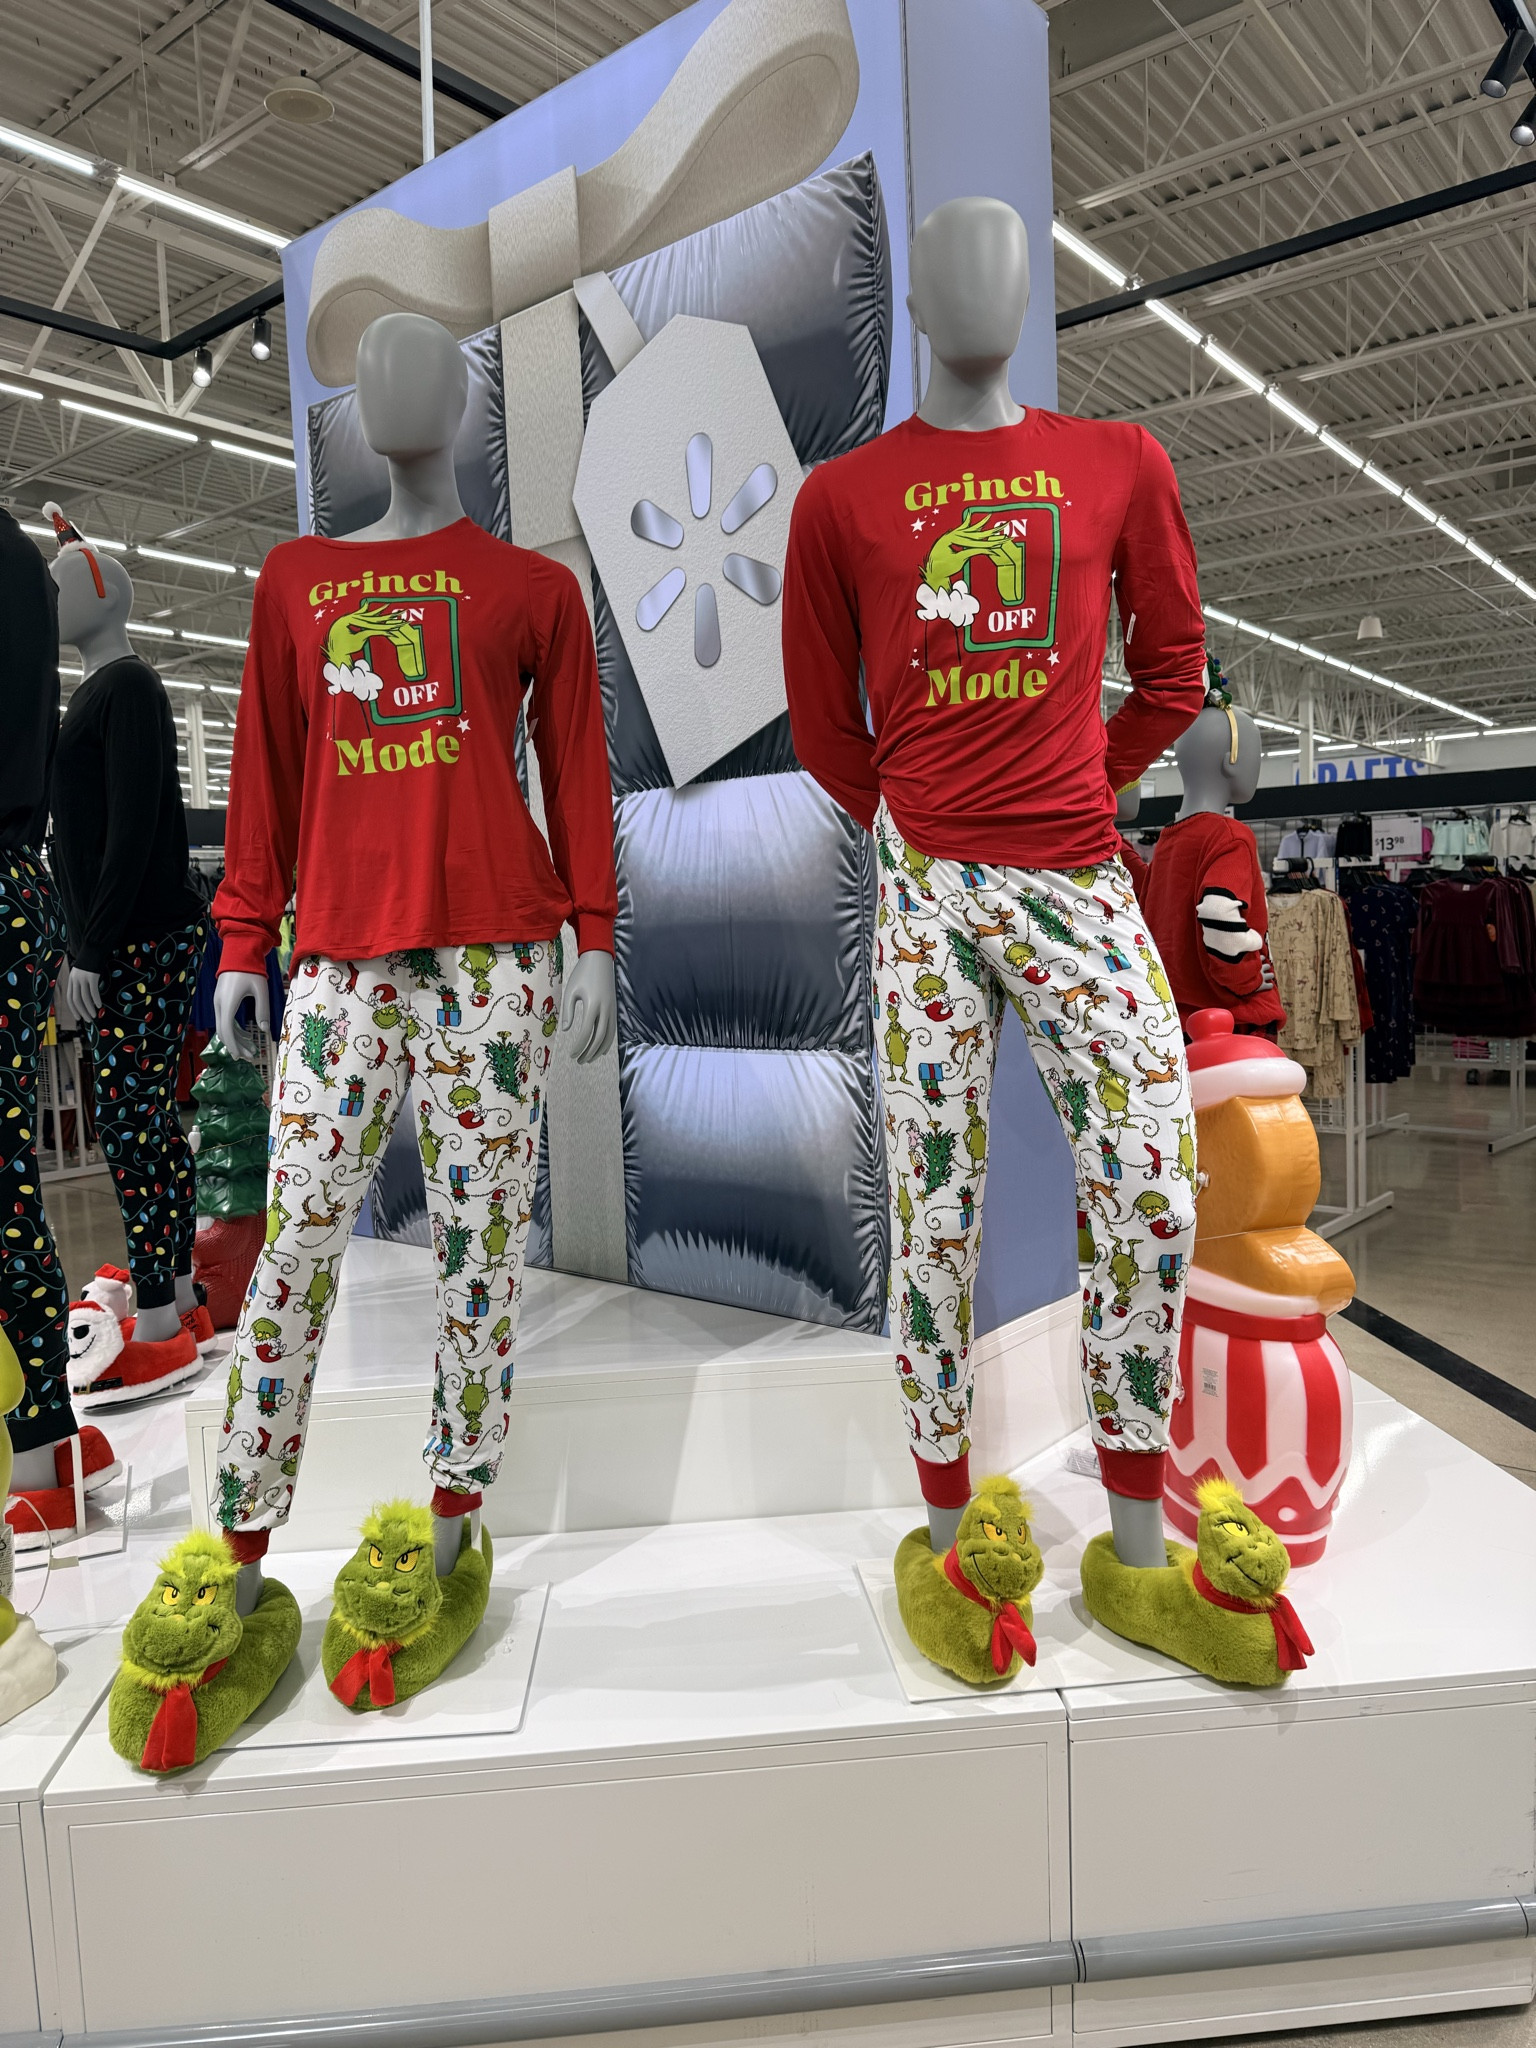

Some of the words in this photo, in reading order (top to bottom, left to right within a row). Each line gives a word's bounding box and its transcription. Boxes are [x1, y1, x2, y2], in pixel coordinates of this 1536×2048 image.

[904, 470, 1064, 511] Grinch
[308, 570, 464, 607] Grinch
[987, 607, 1037, 633] OFF
[392, 681, 440, 708] OFF
[924, 658, 1048, 707] Mode
[333, 728, 461, 776] Mode
[1295, 756, 1425, 786] RAFTS
